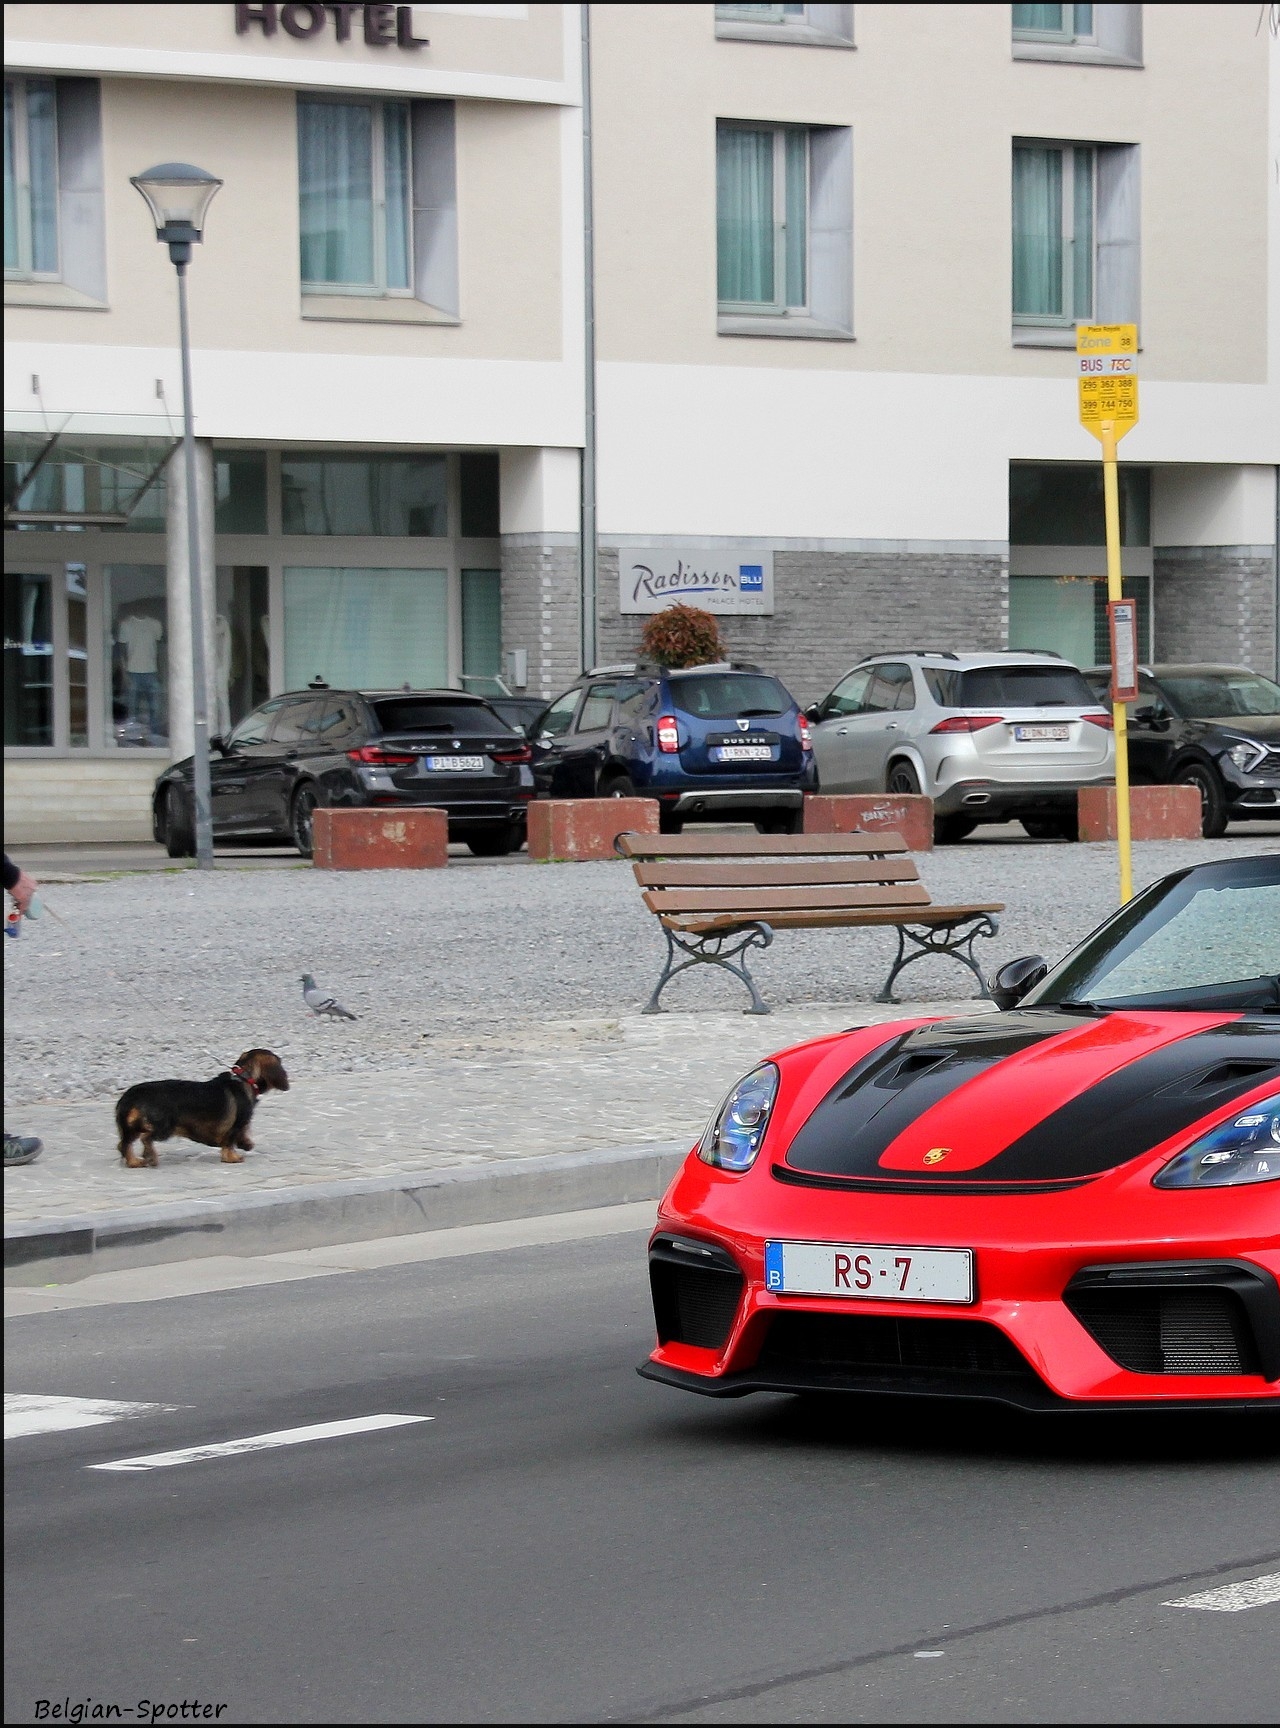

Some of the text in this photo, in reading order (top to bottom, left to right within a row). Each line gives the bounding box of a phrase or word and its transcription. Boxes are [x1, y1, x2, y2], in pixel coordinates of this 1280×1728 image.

[235, 4, 430, 47] HOTEL
[1080, 336, 1131, 349] Zone 38
[1080, 358, 1132, 372] BUS TEC
[1083, 381, 1098, 390] 295
[1100, 380, 1115, 389] 362
[1083, 401, 1098, 410] 399
[1101, 400, 1116, 409] 744
[1118, 399, 1133, 408] 750
[632, 559, 737, 603] Radisson
[707, 598, 764, 606] PALACE HOTEL
[769, 1270, 781, 1286] B
